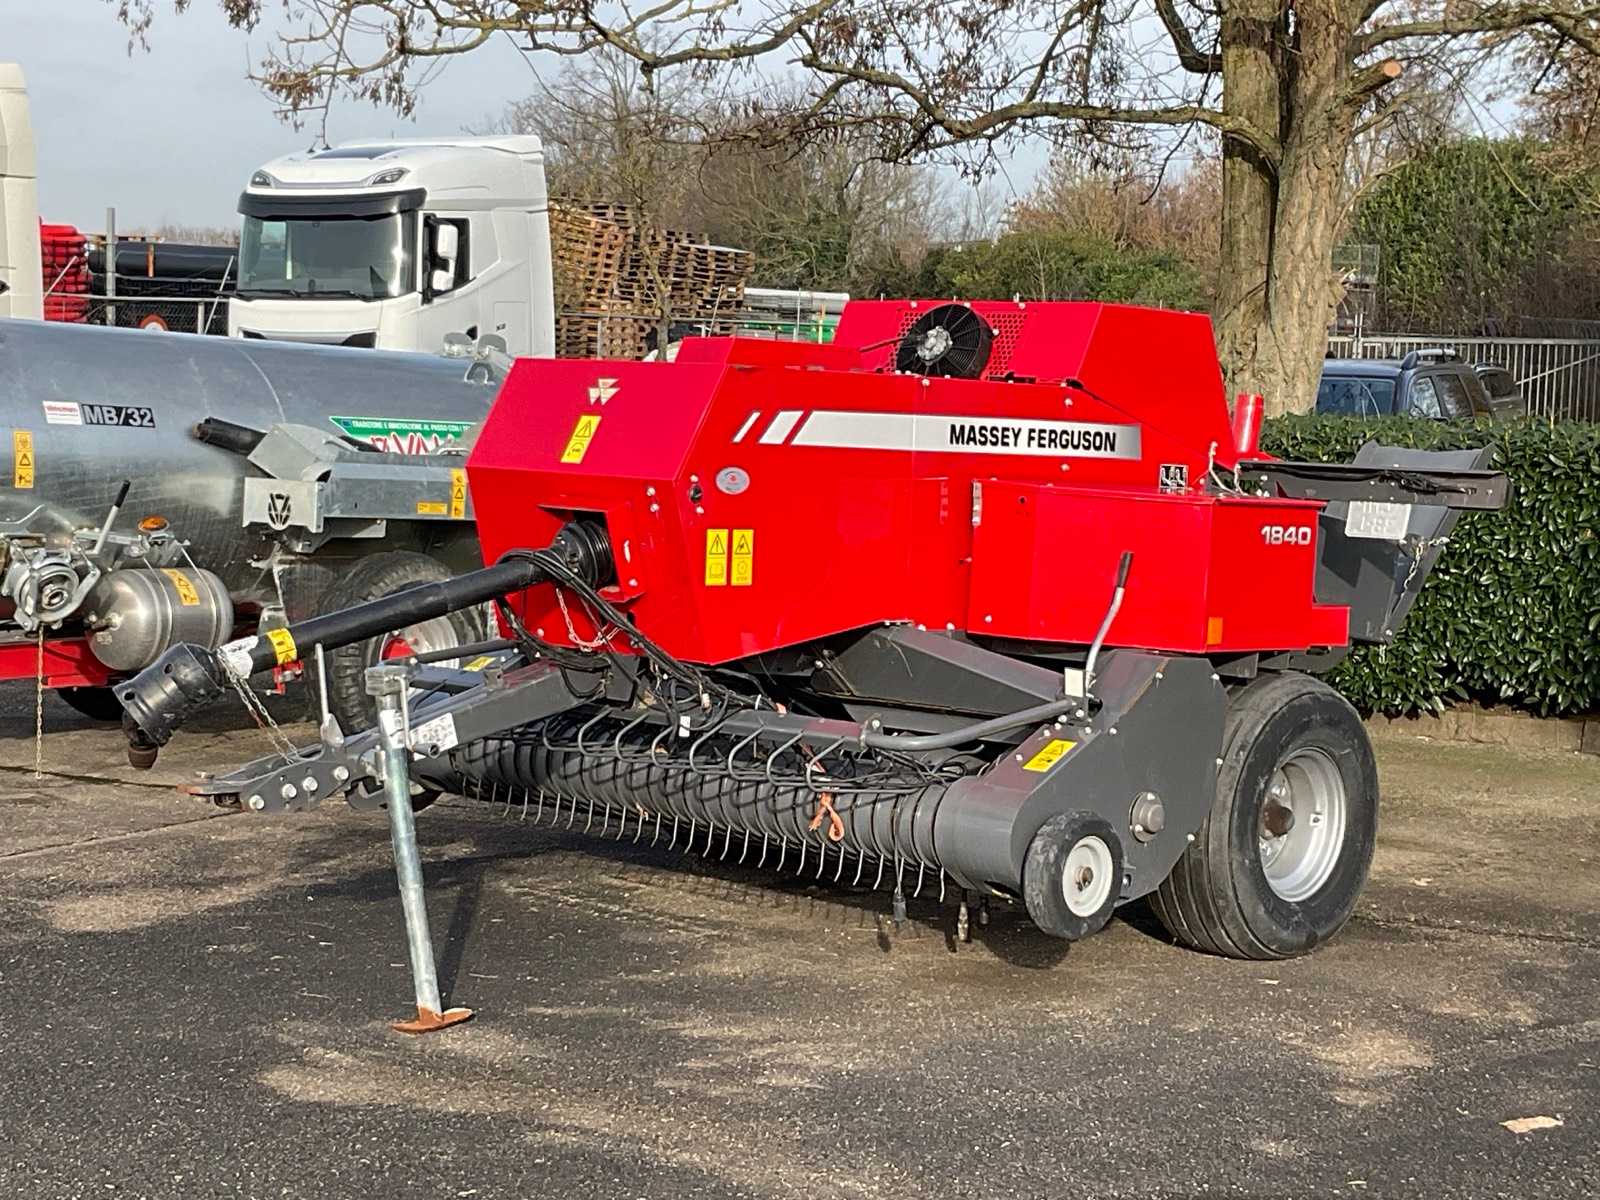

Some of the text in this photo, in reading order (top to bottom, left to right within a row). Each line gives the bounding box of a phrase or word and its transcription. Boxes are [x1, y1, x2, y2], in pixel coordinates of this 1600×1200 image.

[82, 405, 154, 427] MB/32
[950, 424, 1117, 452] MASSEY FERGUSON
[1261, 525, 1312, 545] 1840
